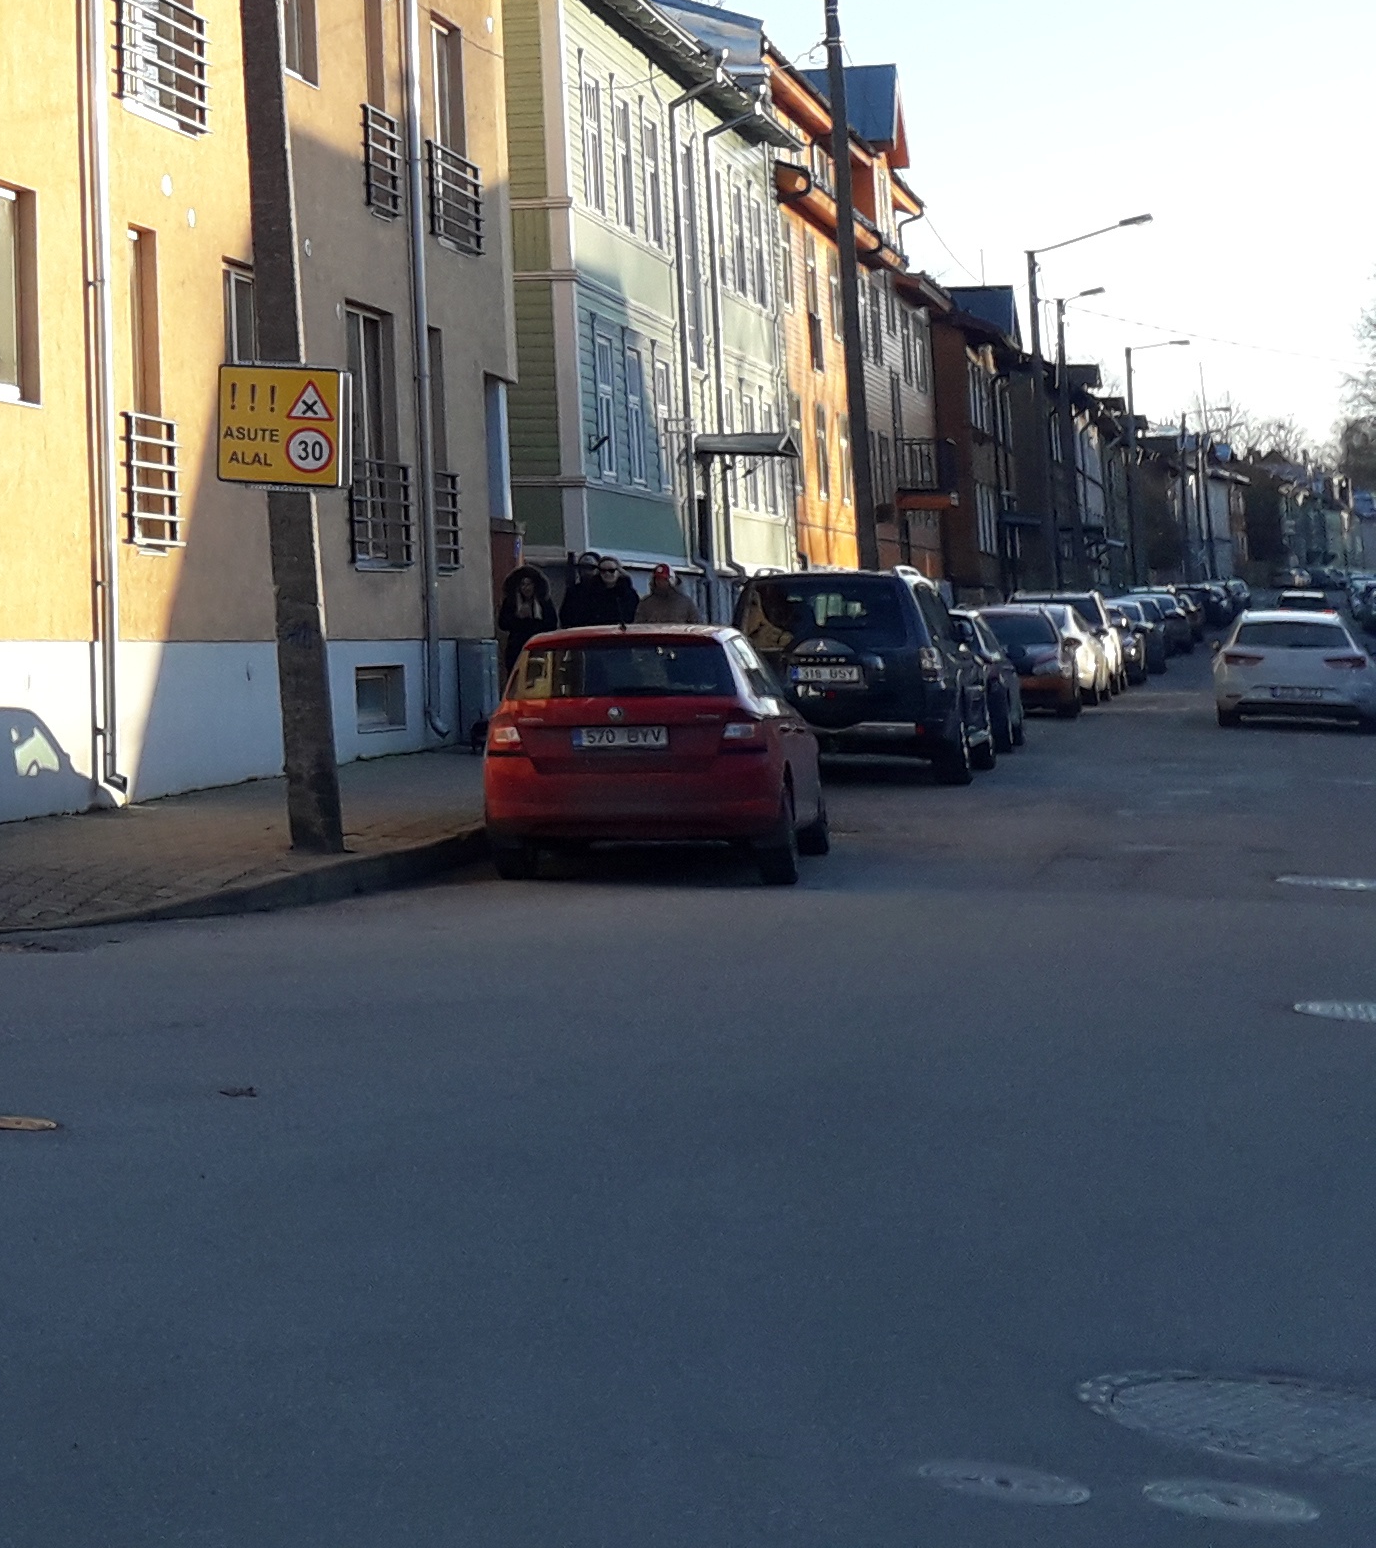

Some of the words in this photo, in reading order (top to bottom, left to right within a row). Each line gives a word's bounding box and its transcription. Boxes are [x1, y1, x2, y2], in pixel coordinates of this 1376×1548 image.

[223, 425, 280, 443] ASUTE
[228, 451, 273, 467] ALAL
[298, 440, 323, 461] 30
